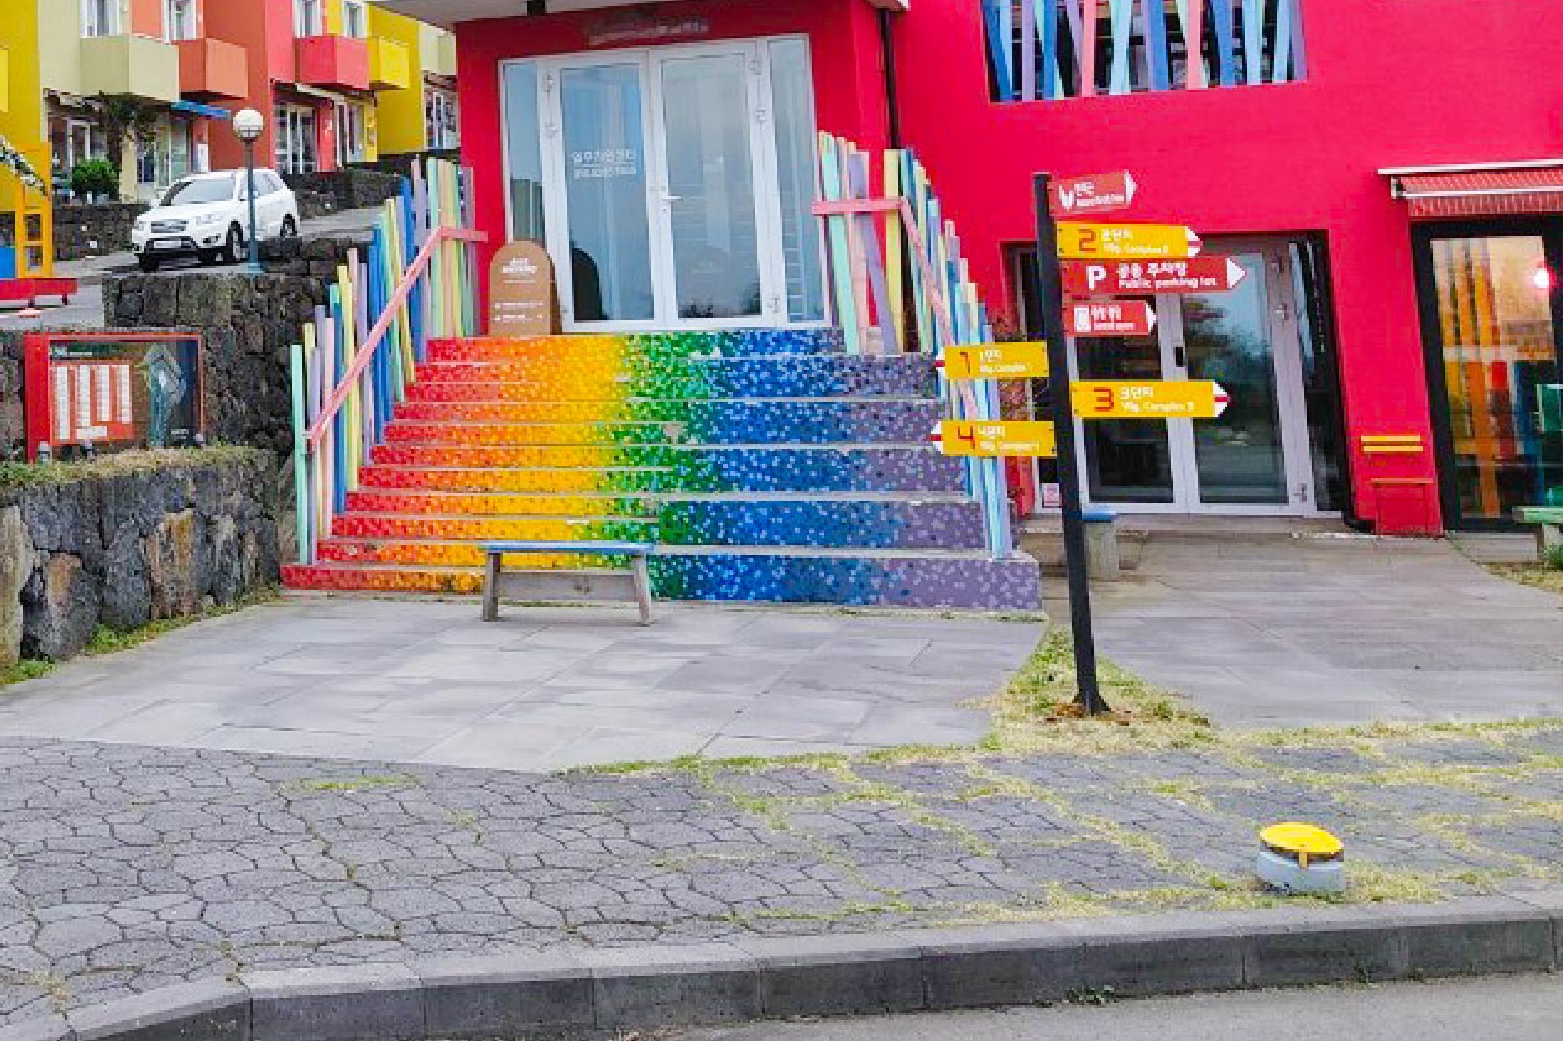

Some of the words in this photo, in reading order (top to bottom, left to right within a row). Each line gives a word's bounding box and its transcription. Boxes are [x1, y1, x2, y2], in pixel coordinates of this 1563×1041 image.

[1078, 229, 1096, 252] 2
[1086, 265, 1106, 290] P
[1094, 386, 1114, 413] 3
[957, 425, 975, 450] 4
